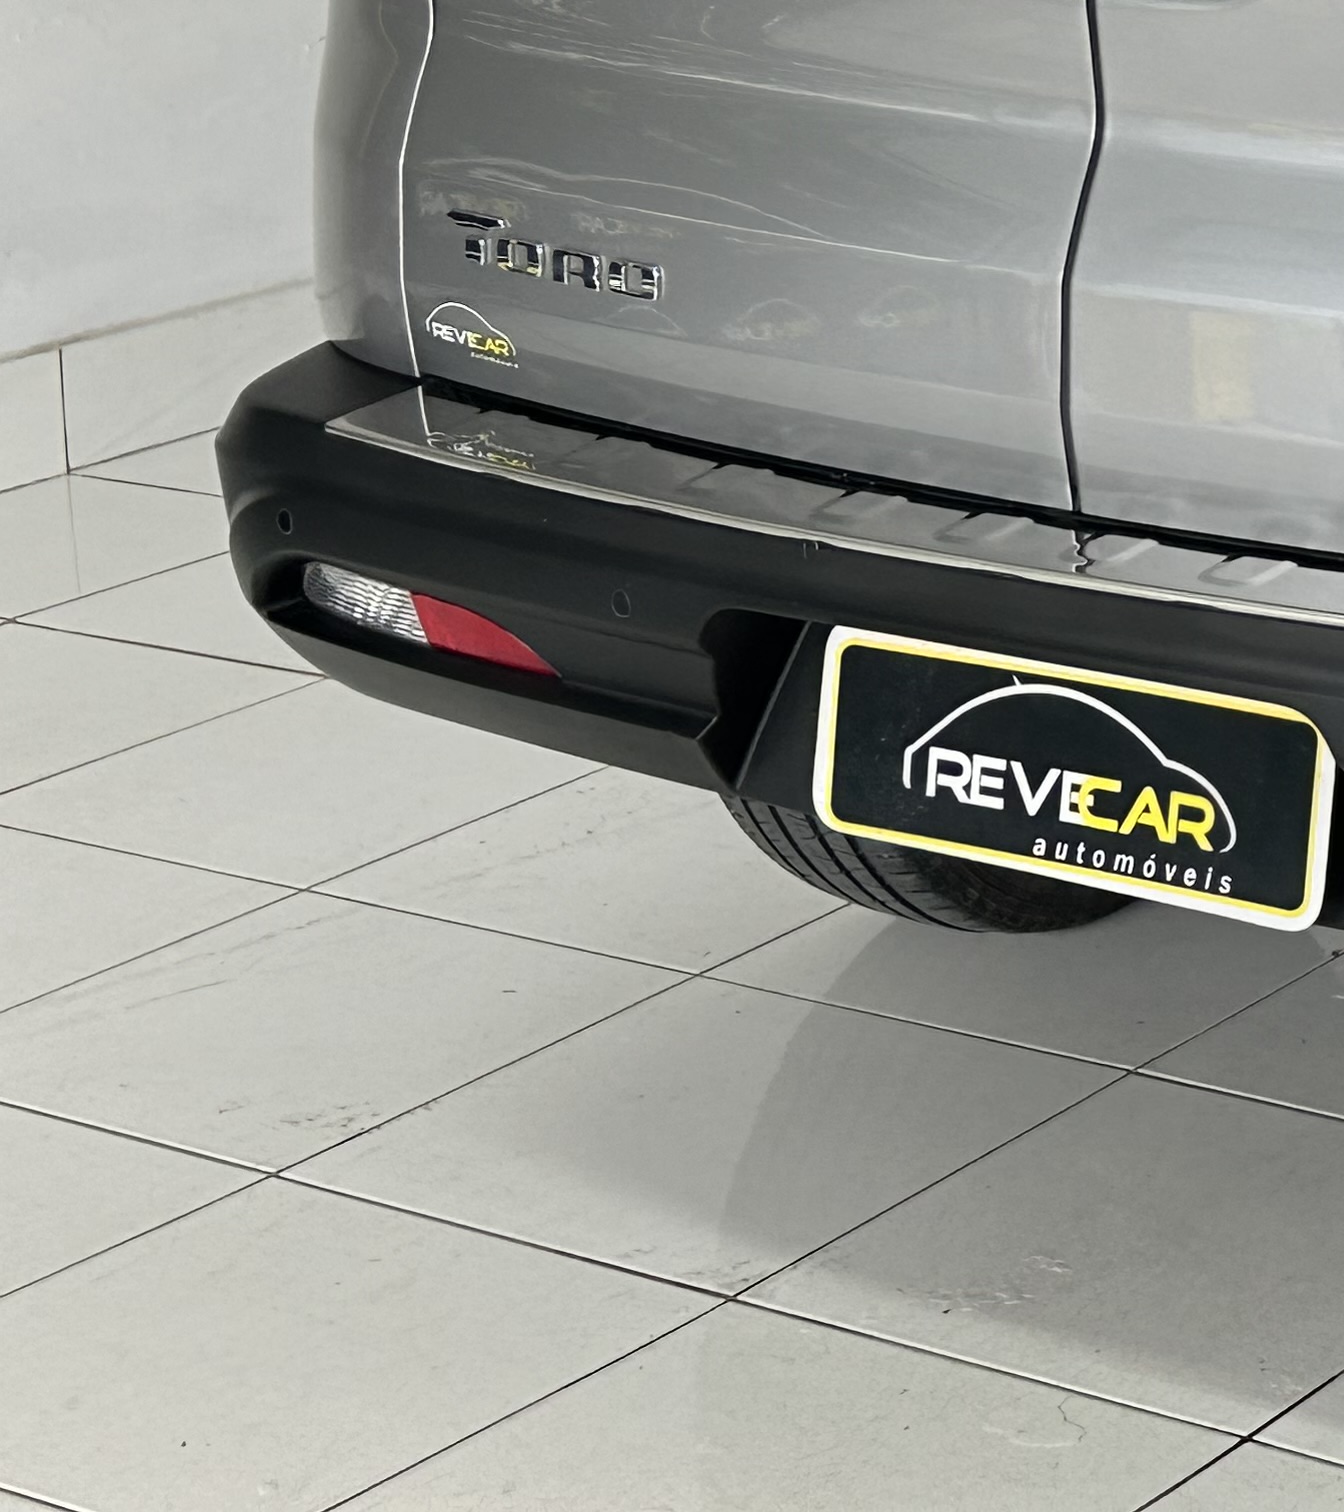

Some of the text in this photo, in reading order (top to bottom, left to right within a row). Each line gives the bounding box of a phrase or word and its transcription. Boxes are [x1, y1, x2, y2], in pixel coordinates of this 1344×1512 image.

[446, 207, 667, 302] TORO
[925, 745, 1216, 853] REVECAR
[1032, 836, 1233, 895] automóveis
